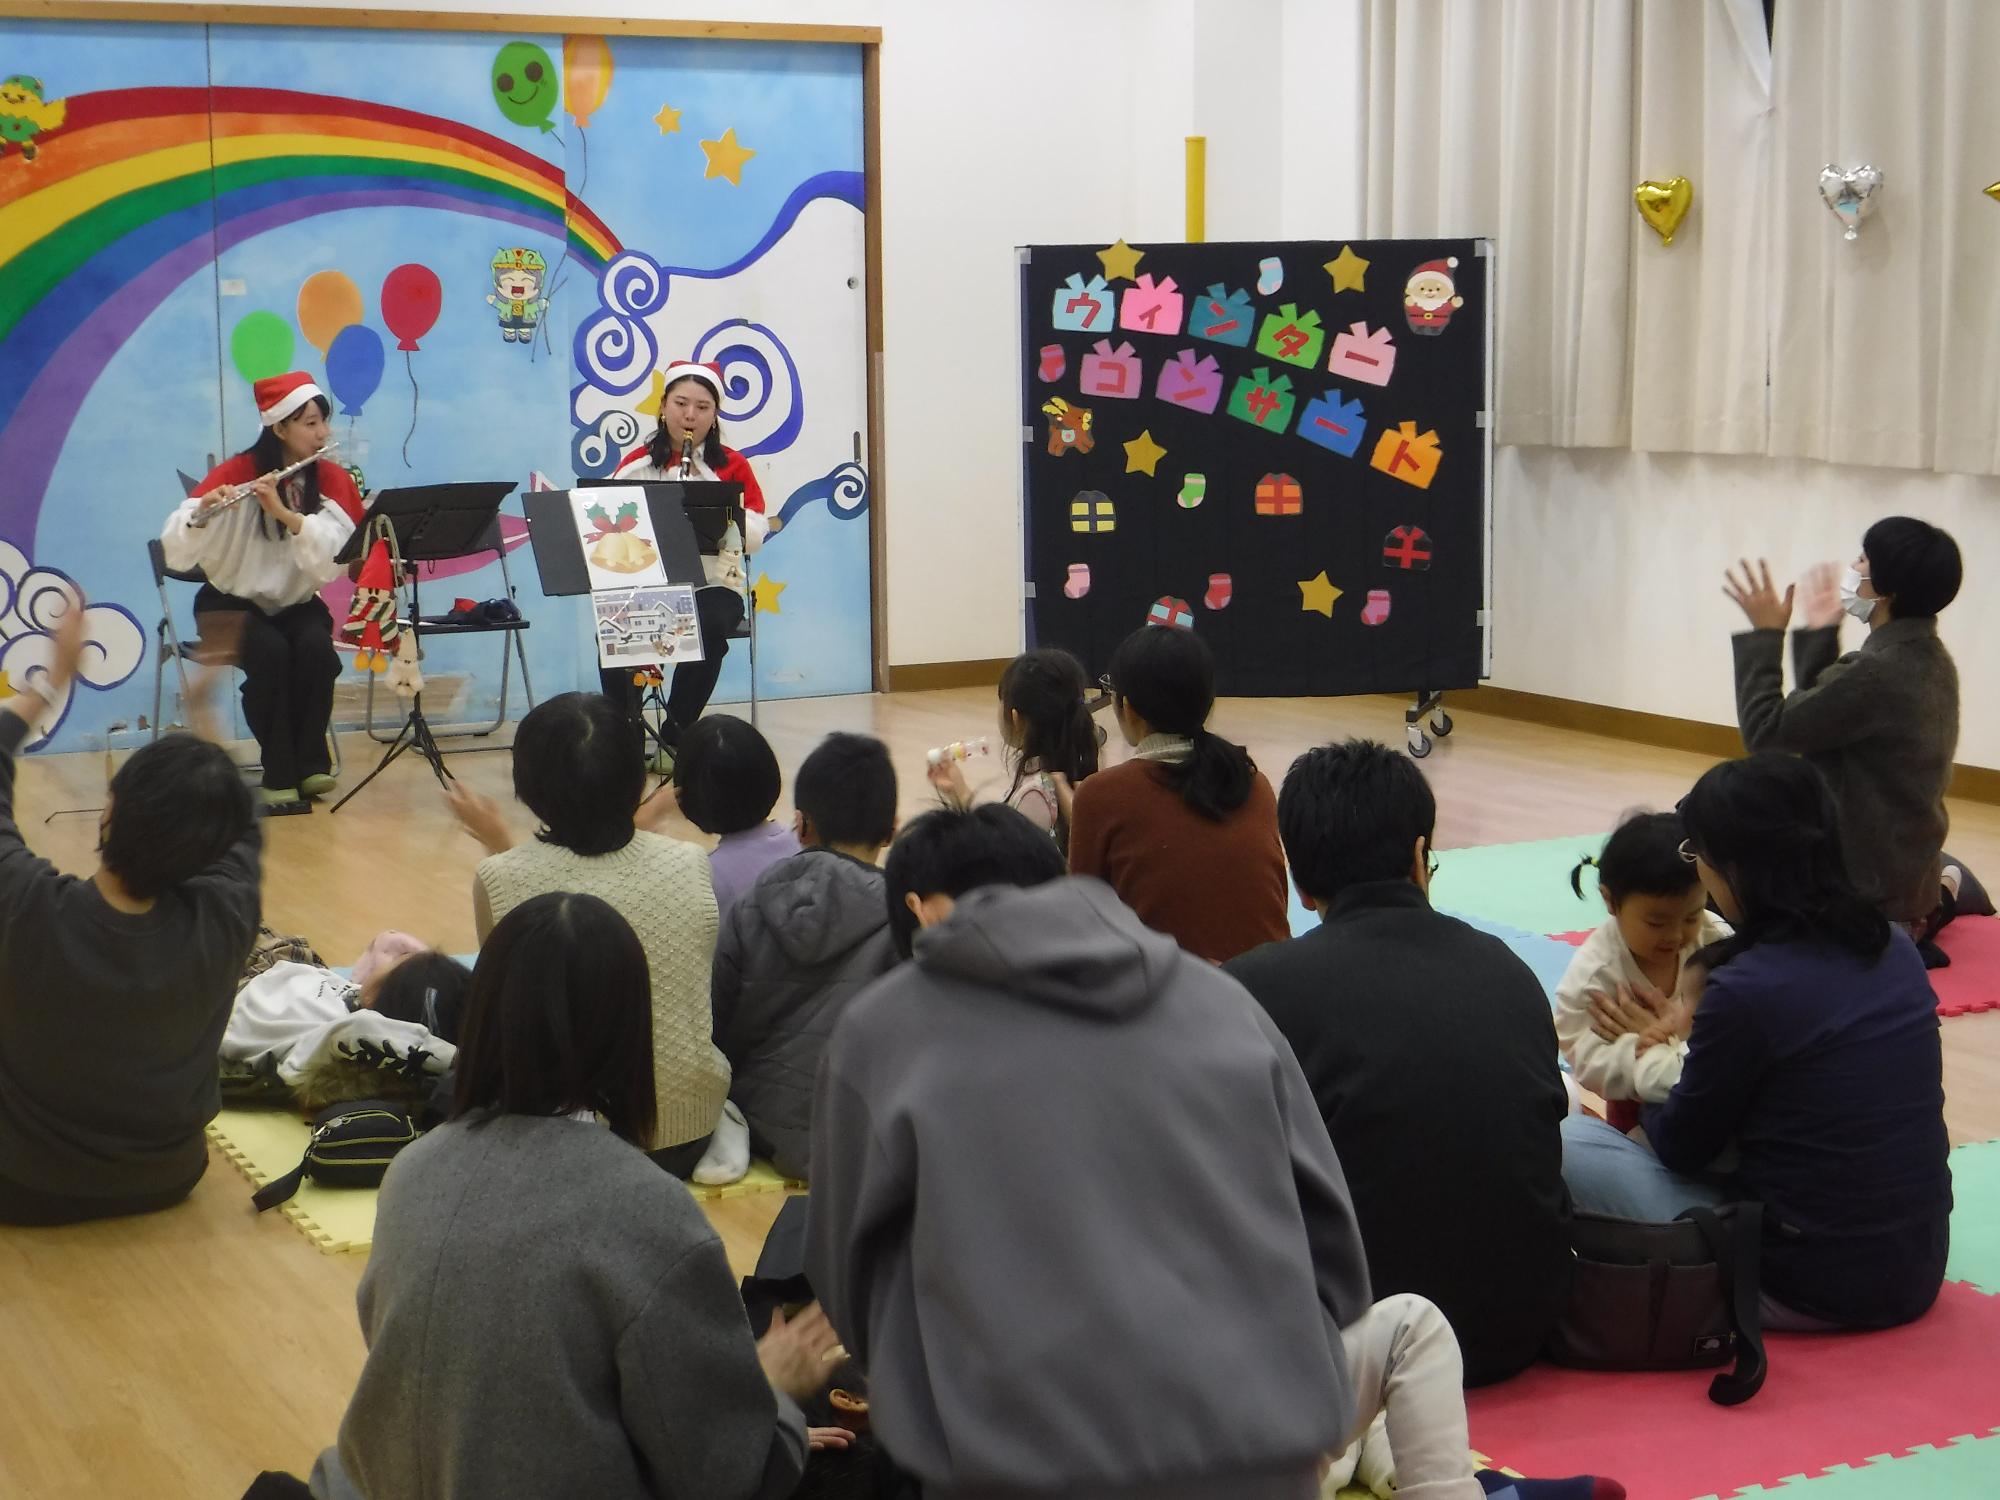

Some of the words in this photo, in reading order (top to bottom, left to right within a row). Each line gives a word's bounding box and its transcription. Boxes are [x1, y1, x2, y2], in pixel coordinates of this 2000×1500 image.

[1065, 291, 1380, 367] ウィンター
[1095, 361, 1421, 474] コンサート
